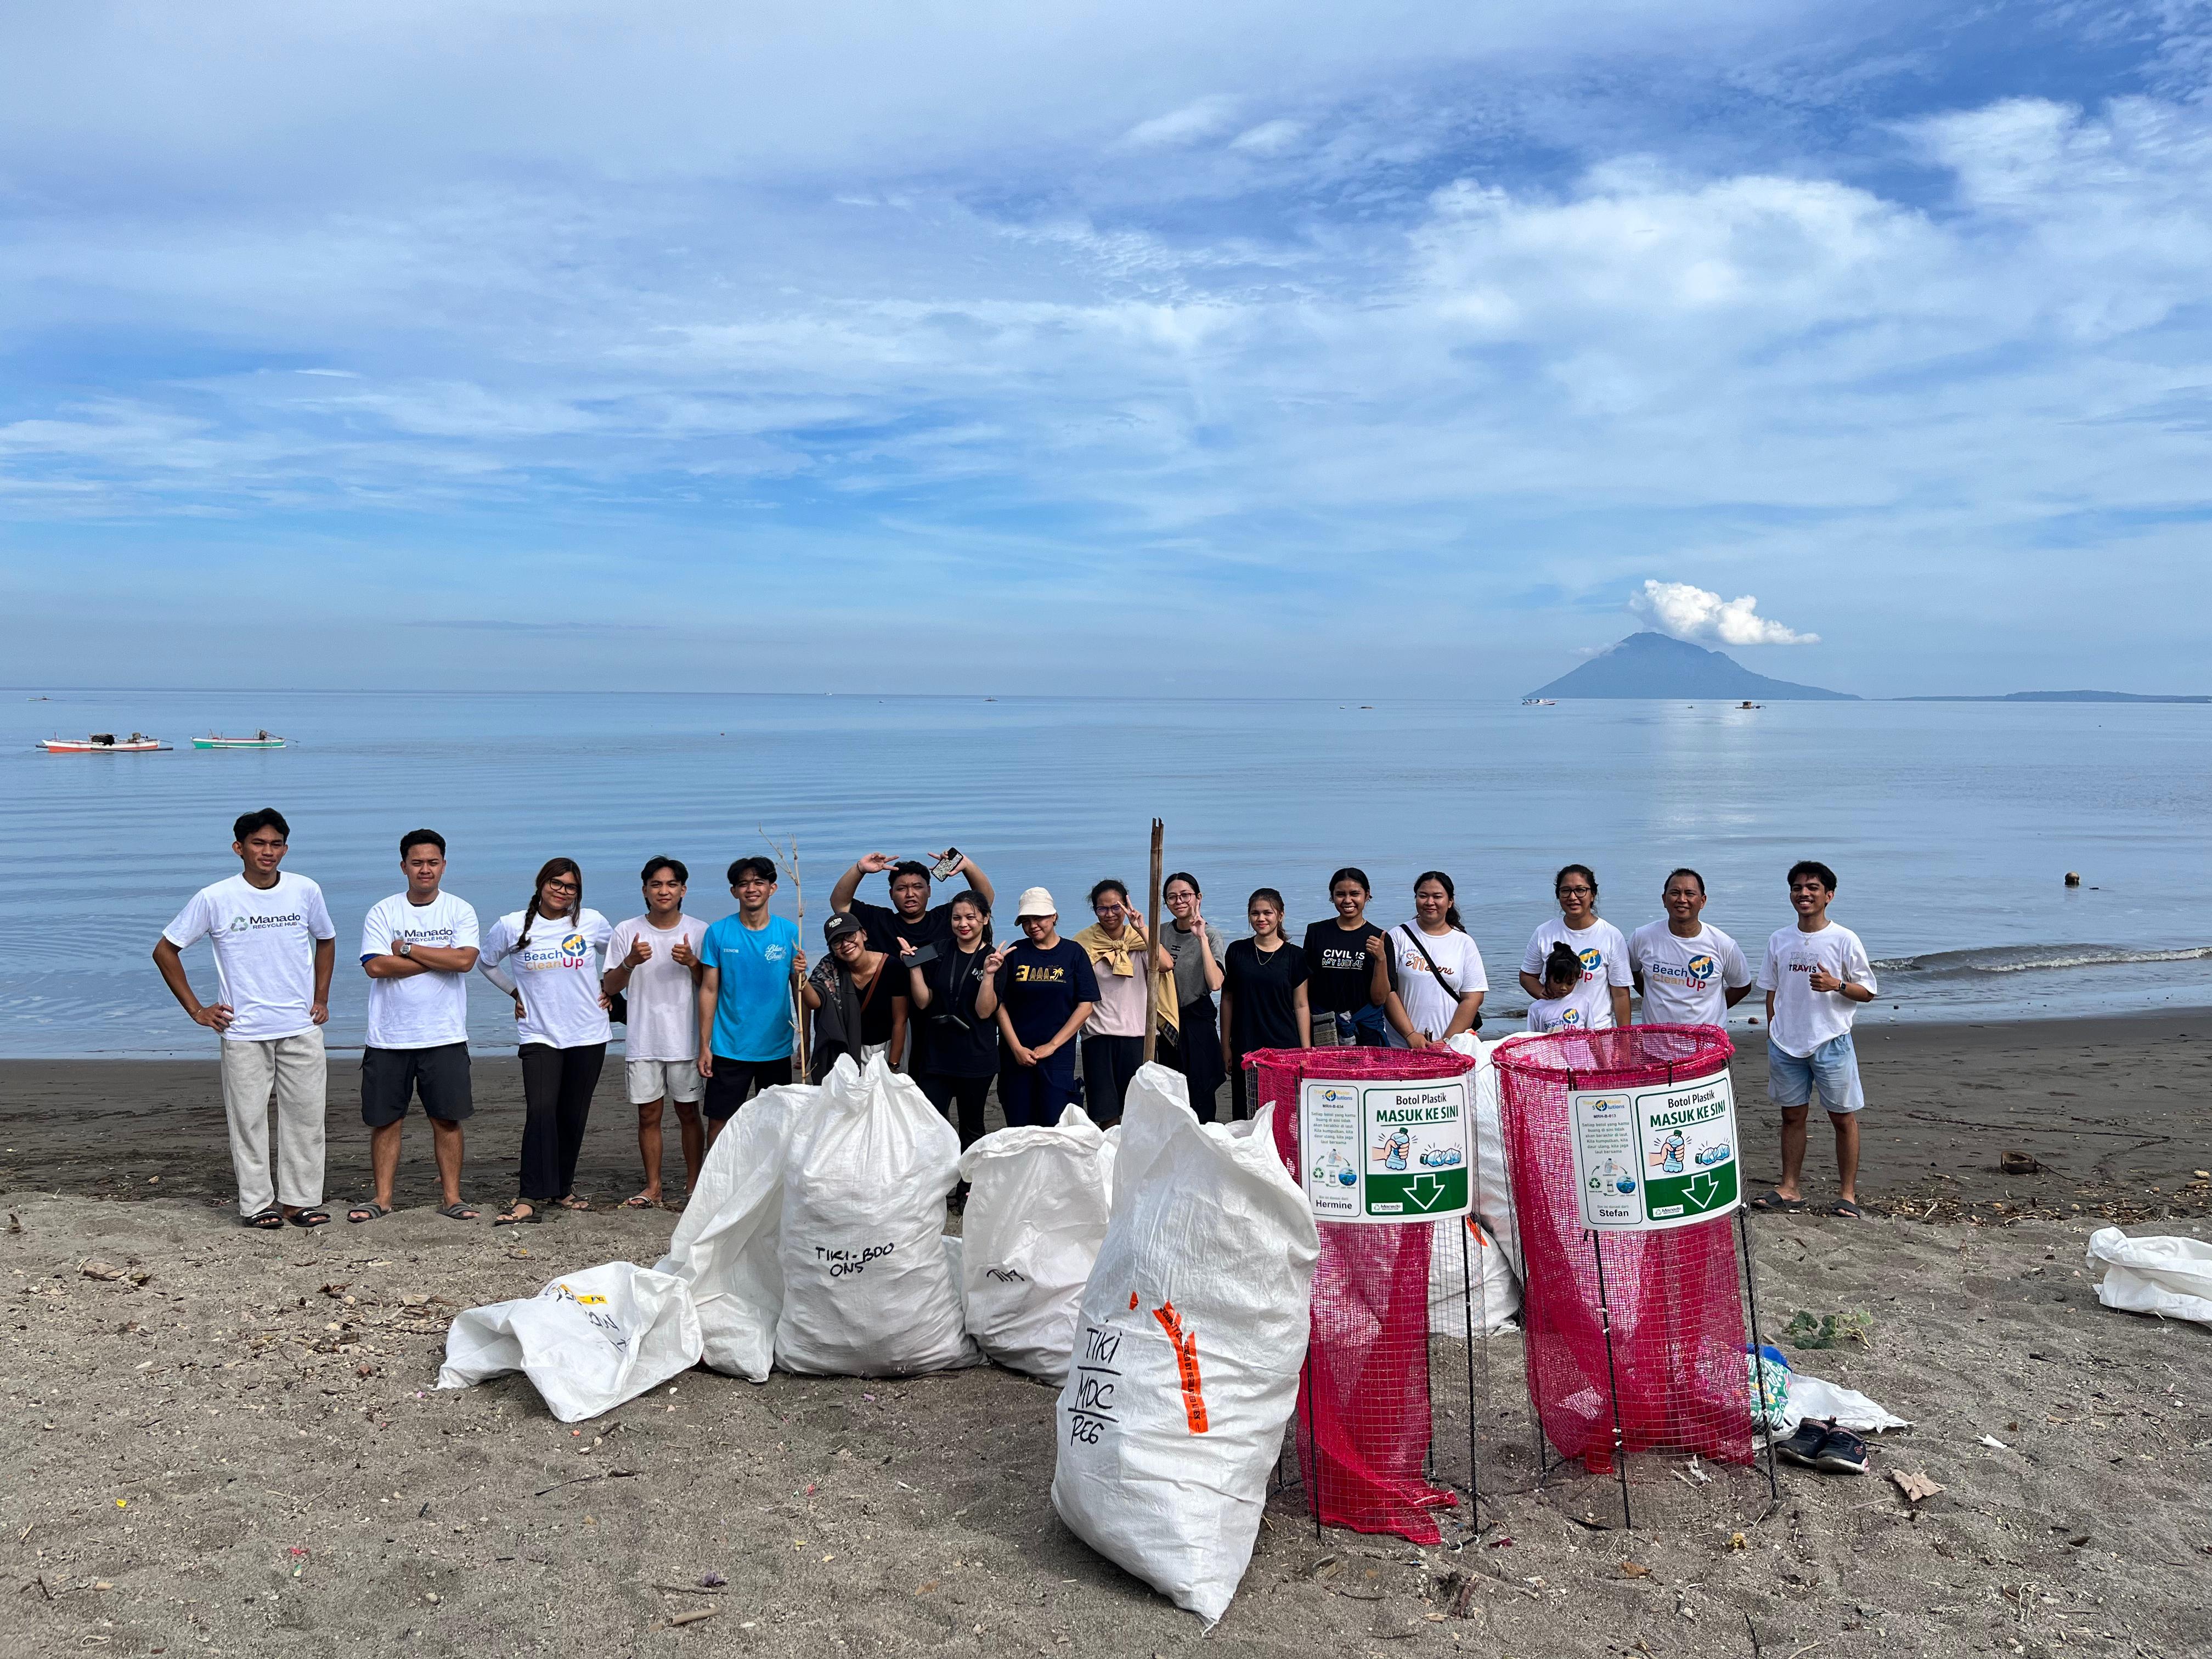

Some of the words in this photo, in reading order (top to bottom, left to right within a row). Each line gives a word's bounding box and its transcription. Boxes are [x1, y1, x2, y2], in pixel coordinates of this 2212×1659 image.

[250, 913, 301, 924] Manado
[404, 927, 453, 938] Manado
[524, 950, 563, 961] Beach
[1323, 949, 1352, 959] CIVIL
[526, 960, 562, 970] Clean
[563, 957, 584, 970] Up
[1788, 964, 1816, 973] TRAVIS
[1652, 964, 1688, 977] Beach
[1652, 973, 1685, 985] Clean
[1686, 977, 1706, 991] Up
[1543, 1019, 1564, 1030] Beach
[1396, 1094, 1419, 1105] Botol
[1422, 1092, 1447, 1104] Plastik
[1668, 1095, 1690, 1108] Botol
[1692, 1090, 1715, 1104] Plastik
[1376, 1108, 1423, 1122] MASUK
[1425, 1108, 1439, 1120] KE
[1441, 1105, 1458, 1119] SINI
[1650, 1109, 1695, 1127] MASUK
[1696, 1105, 1709, 1120] KE
[1711, 1099, 1726, 1116] SINI
[1316, 1199, 1352, 1209] Hermine
[1086, 1327, 1122, 1364] TIKI
[1184, 1362, 1193, 1370] BY
[1074, 1372, 1114, 1410] MDC
